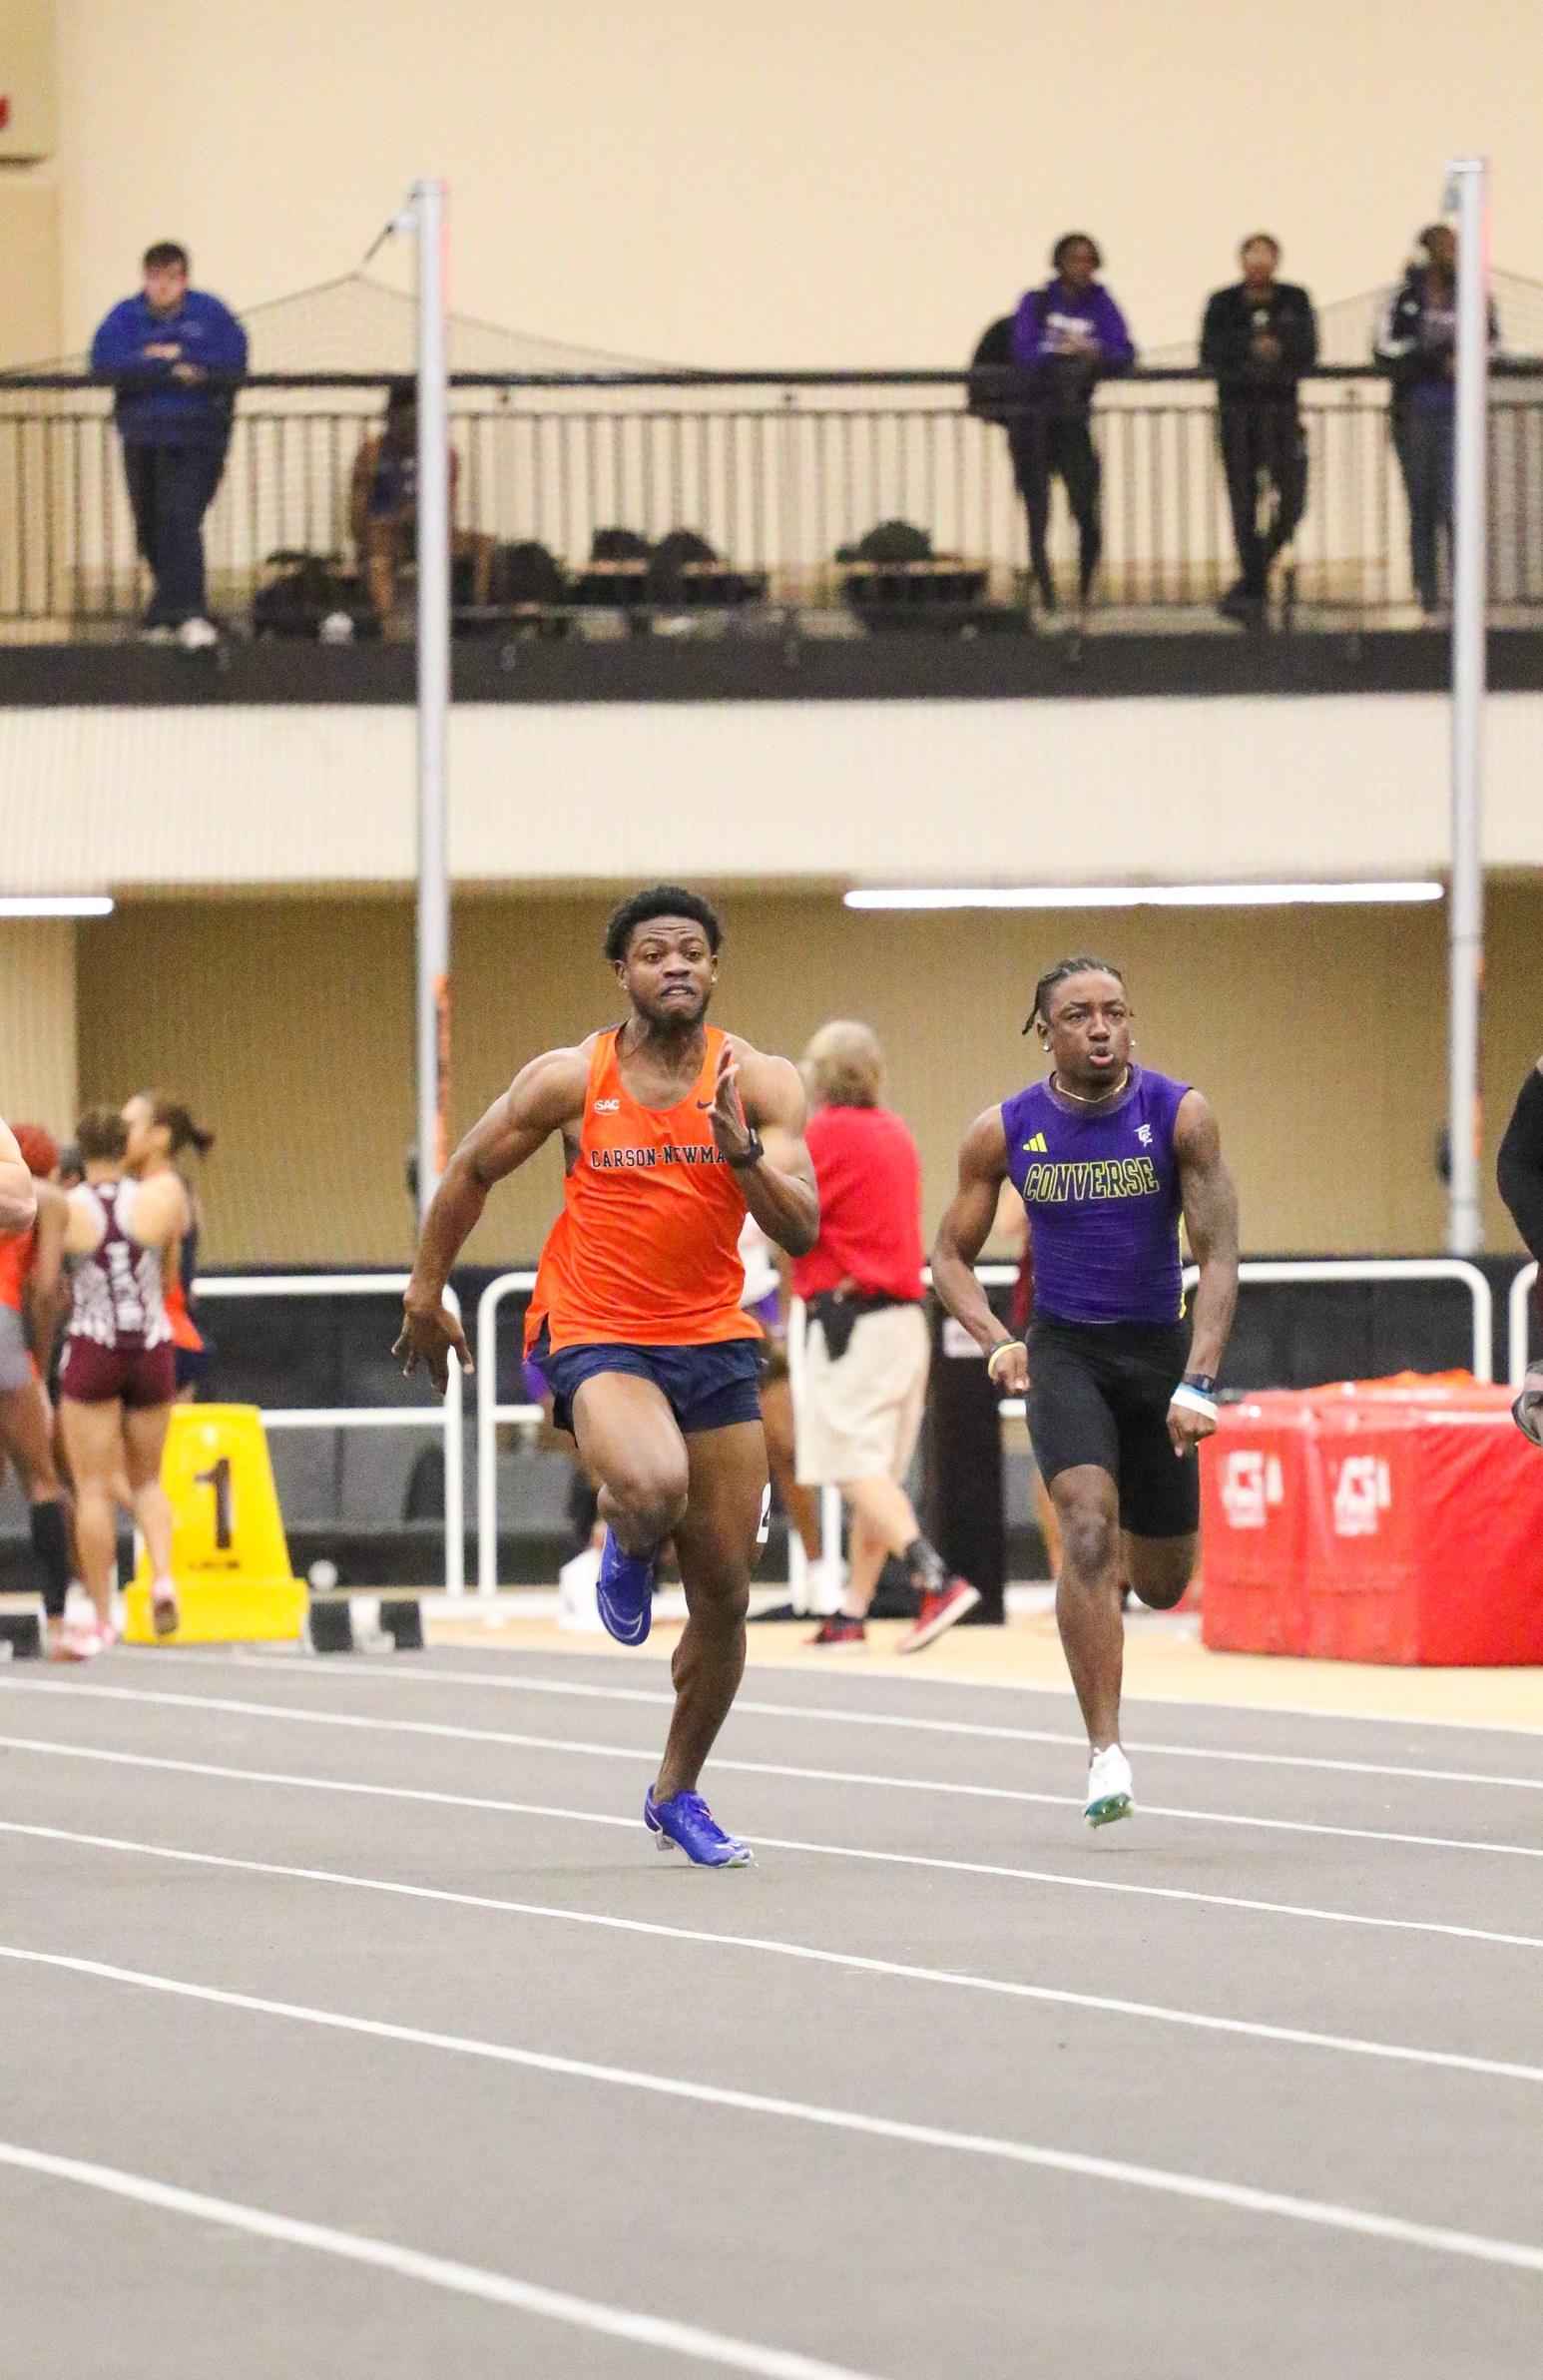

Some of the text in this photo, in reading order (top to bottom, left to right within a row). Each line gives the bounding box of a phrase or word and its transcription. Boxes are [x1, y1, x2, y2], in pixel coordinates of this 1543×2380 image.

[594, 1098, 620, 1111] SAC
[591, 1144, 729, 1169] CARSON-NEWMA
[1023, 1156, 1160, 1202] CONVERSE
[194, 1456, 232, 1549] 1
